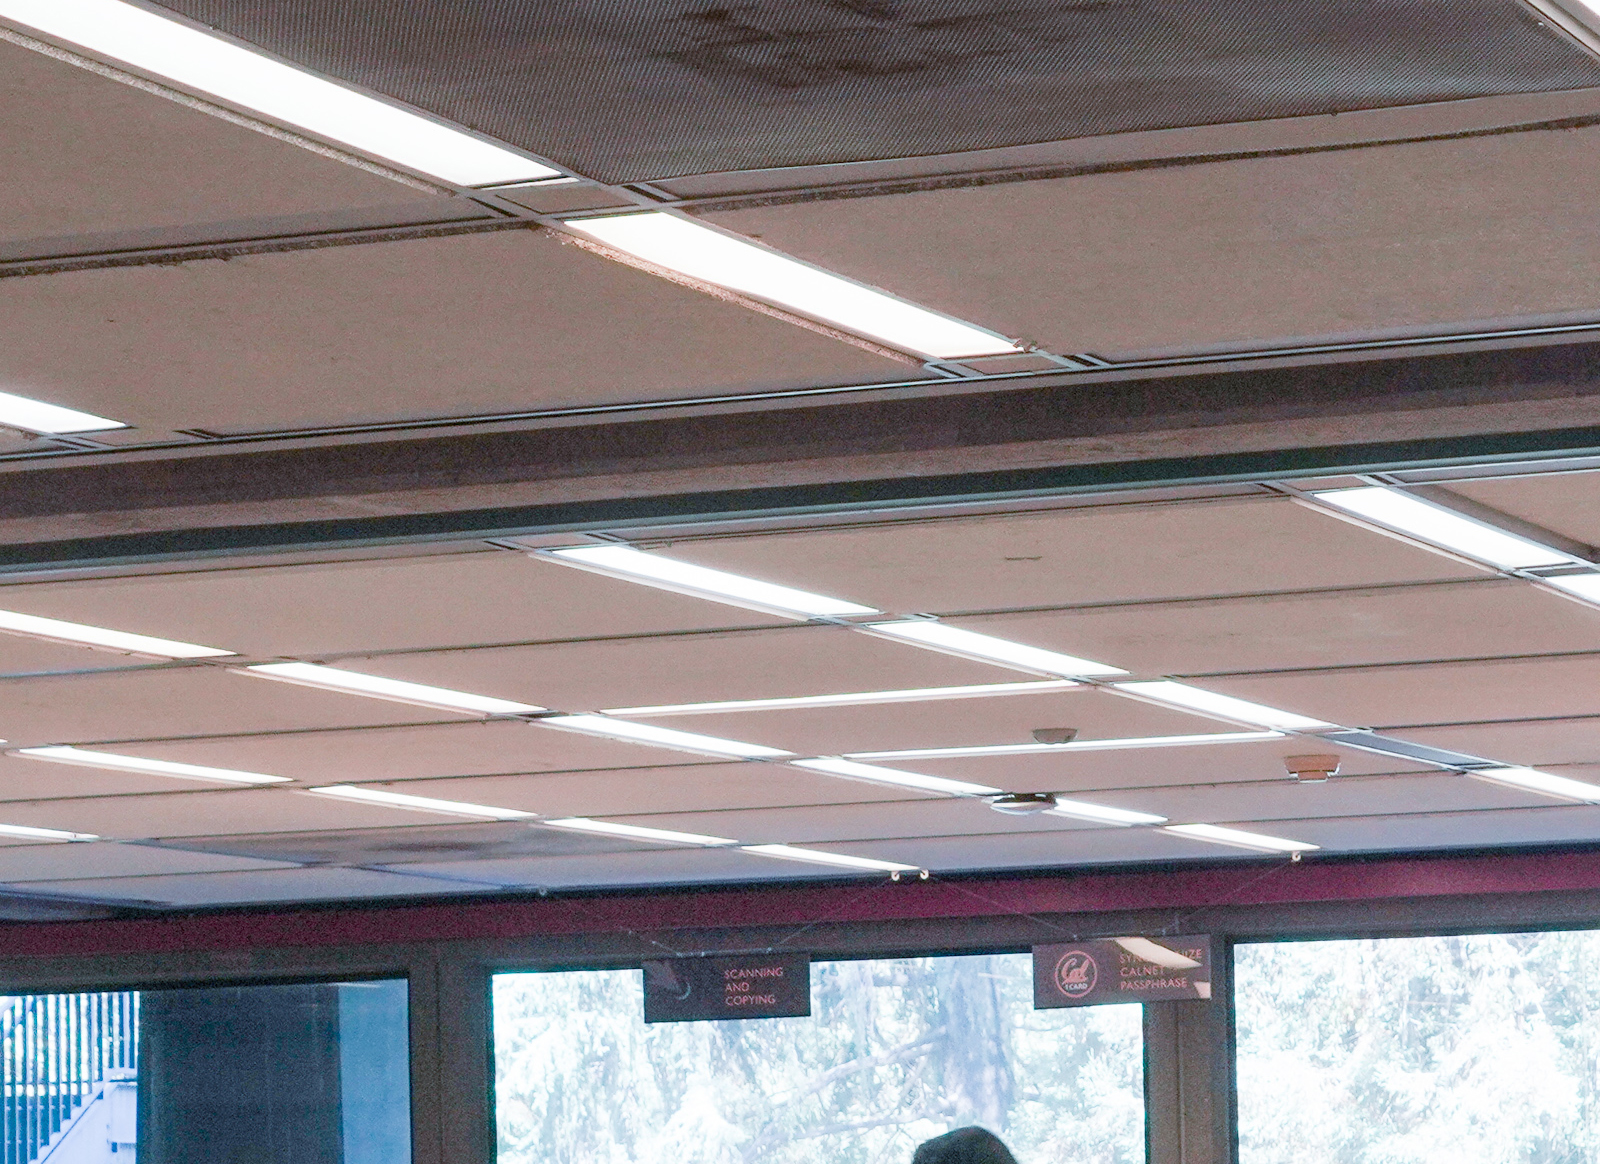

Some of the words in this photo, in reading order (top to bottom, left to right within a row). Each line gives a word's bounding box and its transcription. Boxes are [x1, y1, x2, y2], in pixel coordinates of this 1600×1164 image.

[724, 966, 784, 979] SCANNING
[1120, 966, 1165, 978] CALNET
[725, 981, 750, 992] AND
[1069, 983, 1088, 991] CARD
[1120, 977, 1188, 991] PASSPHRASE
[725, 994, 776, 1006] COPYING
